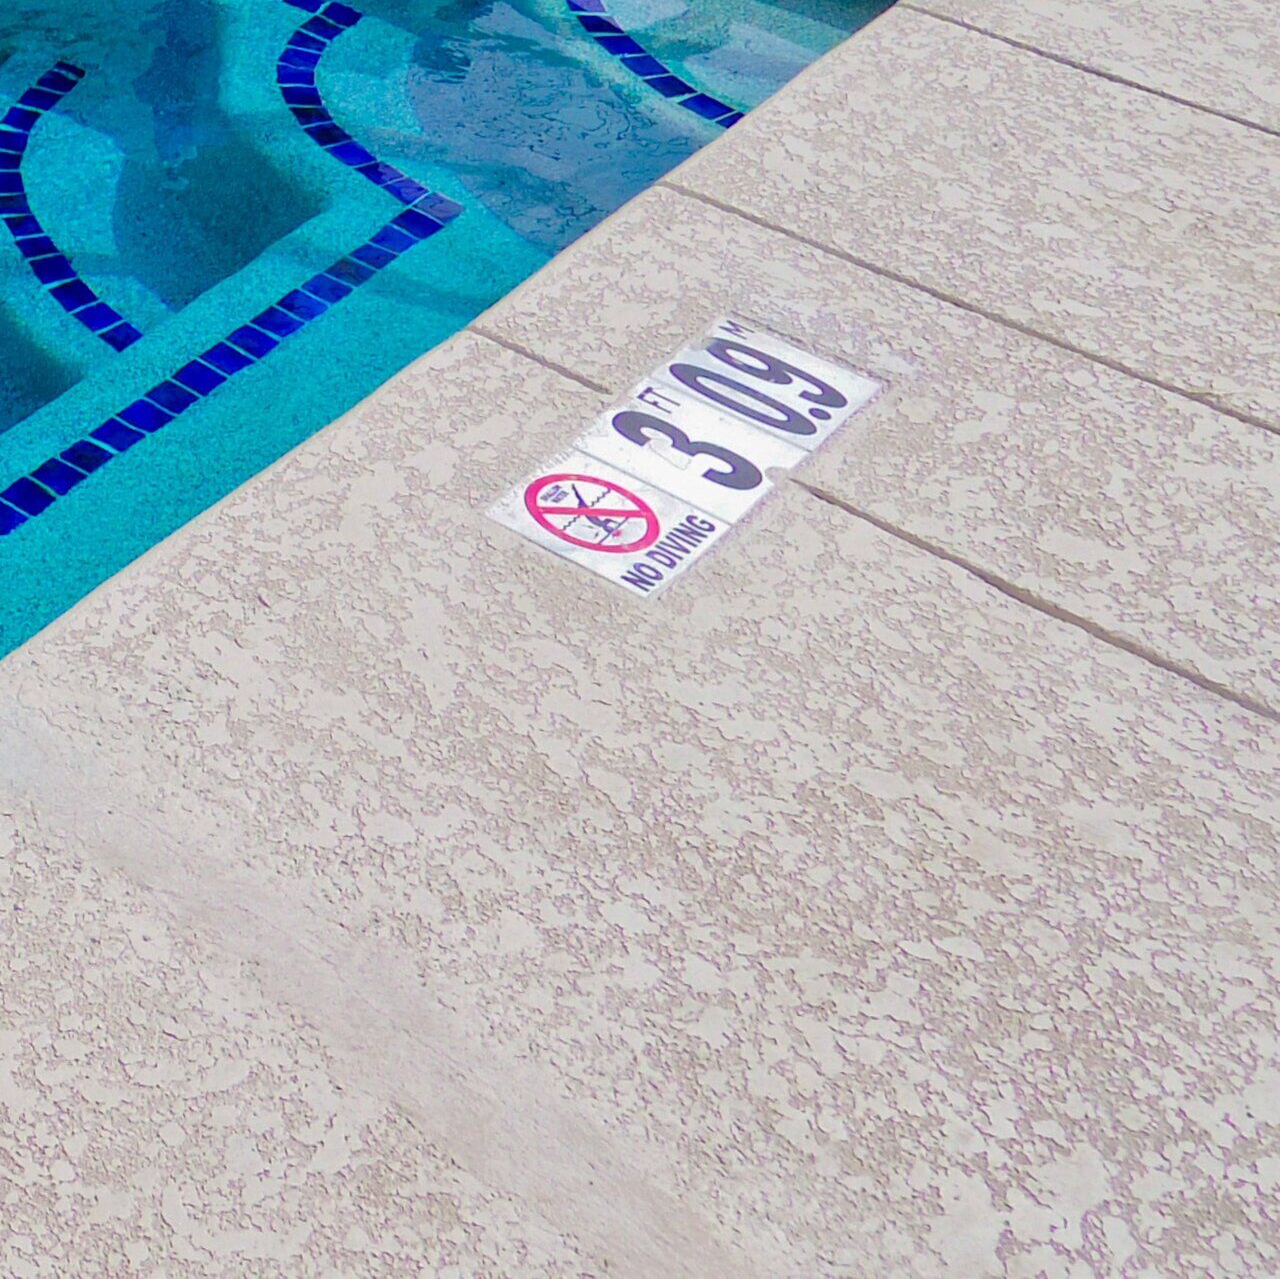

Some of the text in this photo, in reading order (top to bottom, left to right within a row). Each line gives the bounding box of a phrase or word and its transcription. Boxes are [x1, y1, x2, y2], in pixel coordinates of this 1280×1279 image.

[610, 319, 849, 491] 3 FT 0.9 M
[620, 514, 717, 593] NO DIVING
